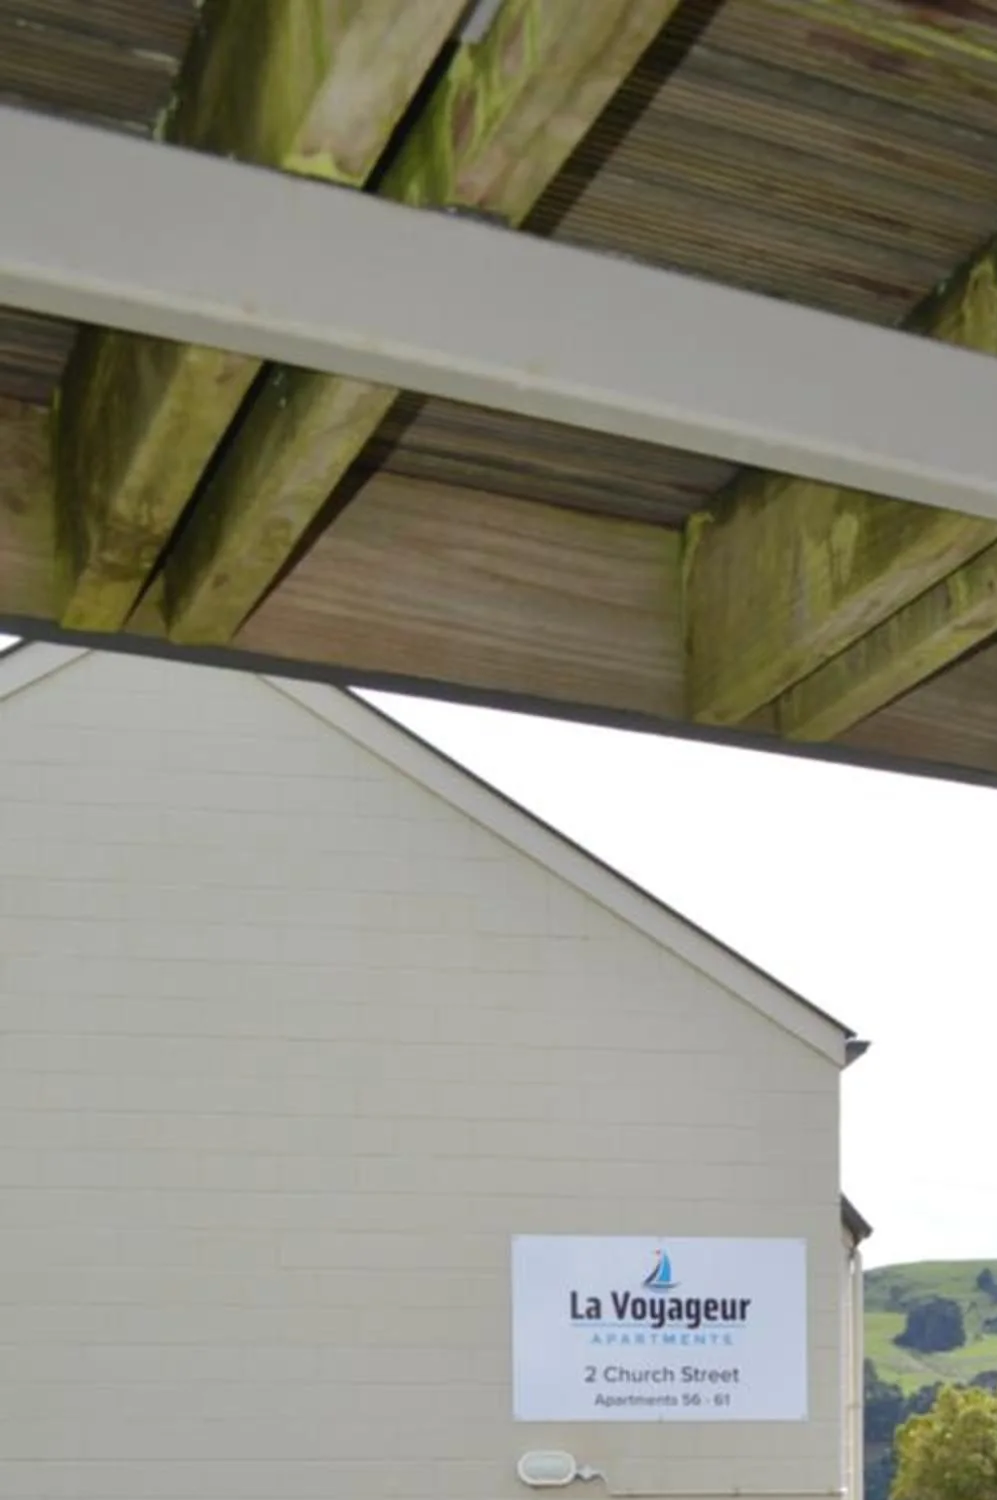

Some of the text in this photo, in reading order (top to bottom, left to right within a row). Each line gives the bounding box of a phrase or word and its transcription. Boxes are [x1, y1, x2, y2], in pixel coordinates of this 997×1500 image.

[570, 1290, 752, 1329] La Voyageur
[592, 1333, 733, 1346] APARTMENTS
[584, 1365, 740, 1383] 2 Church Street
[594, 1393, 678, 1408] Apartments
[682, 1393, 702, 1406] 56
[713, 1393, 730, 1406] 61
